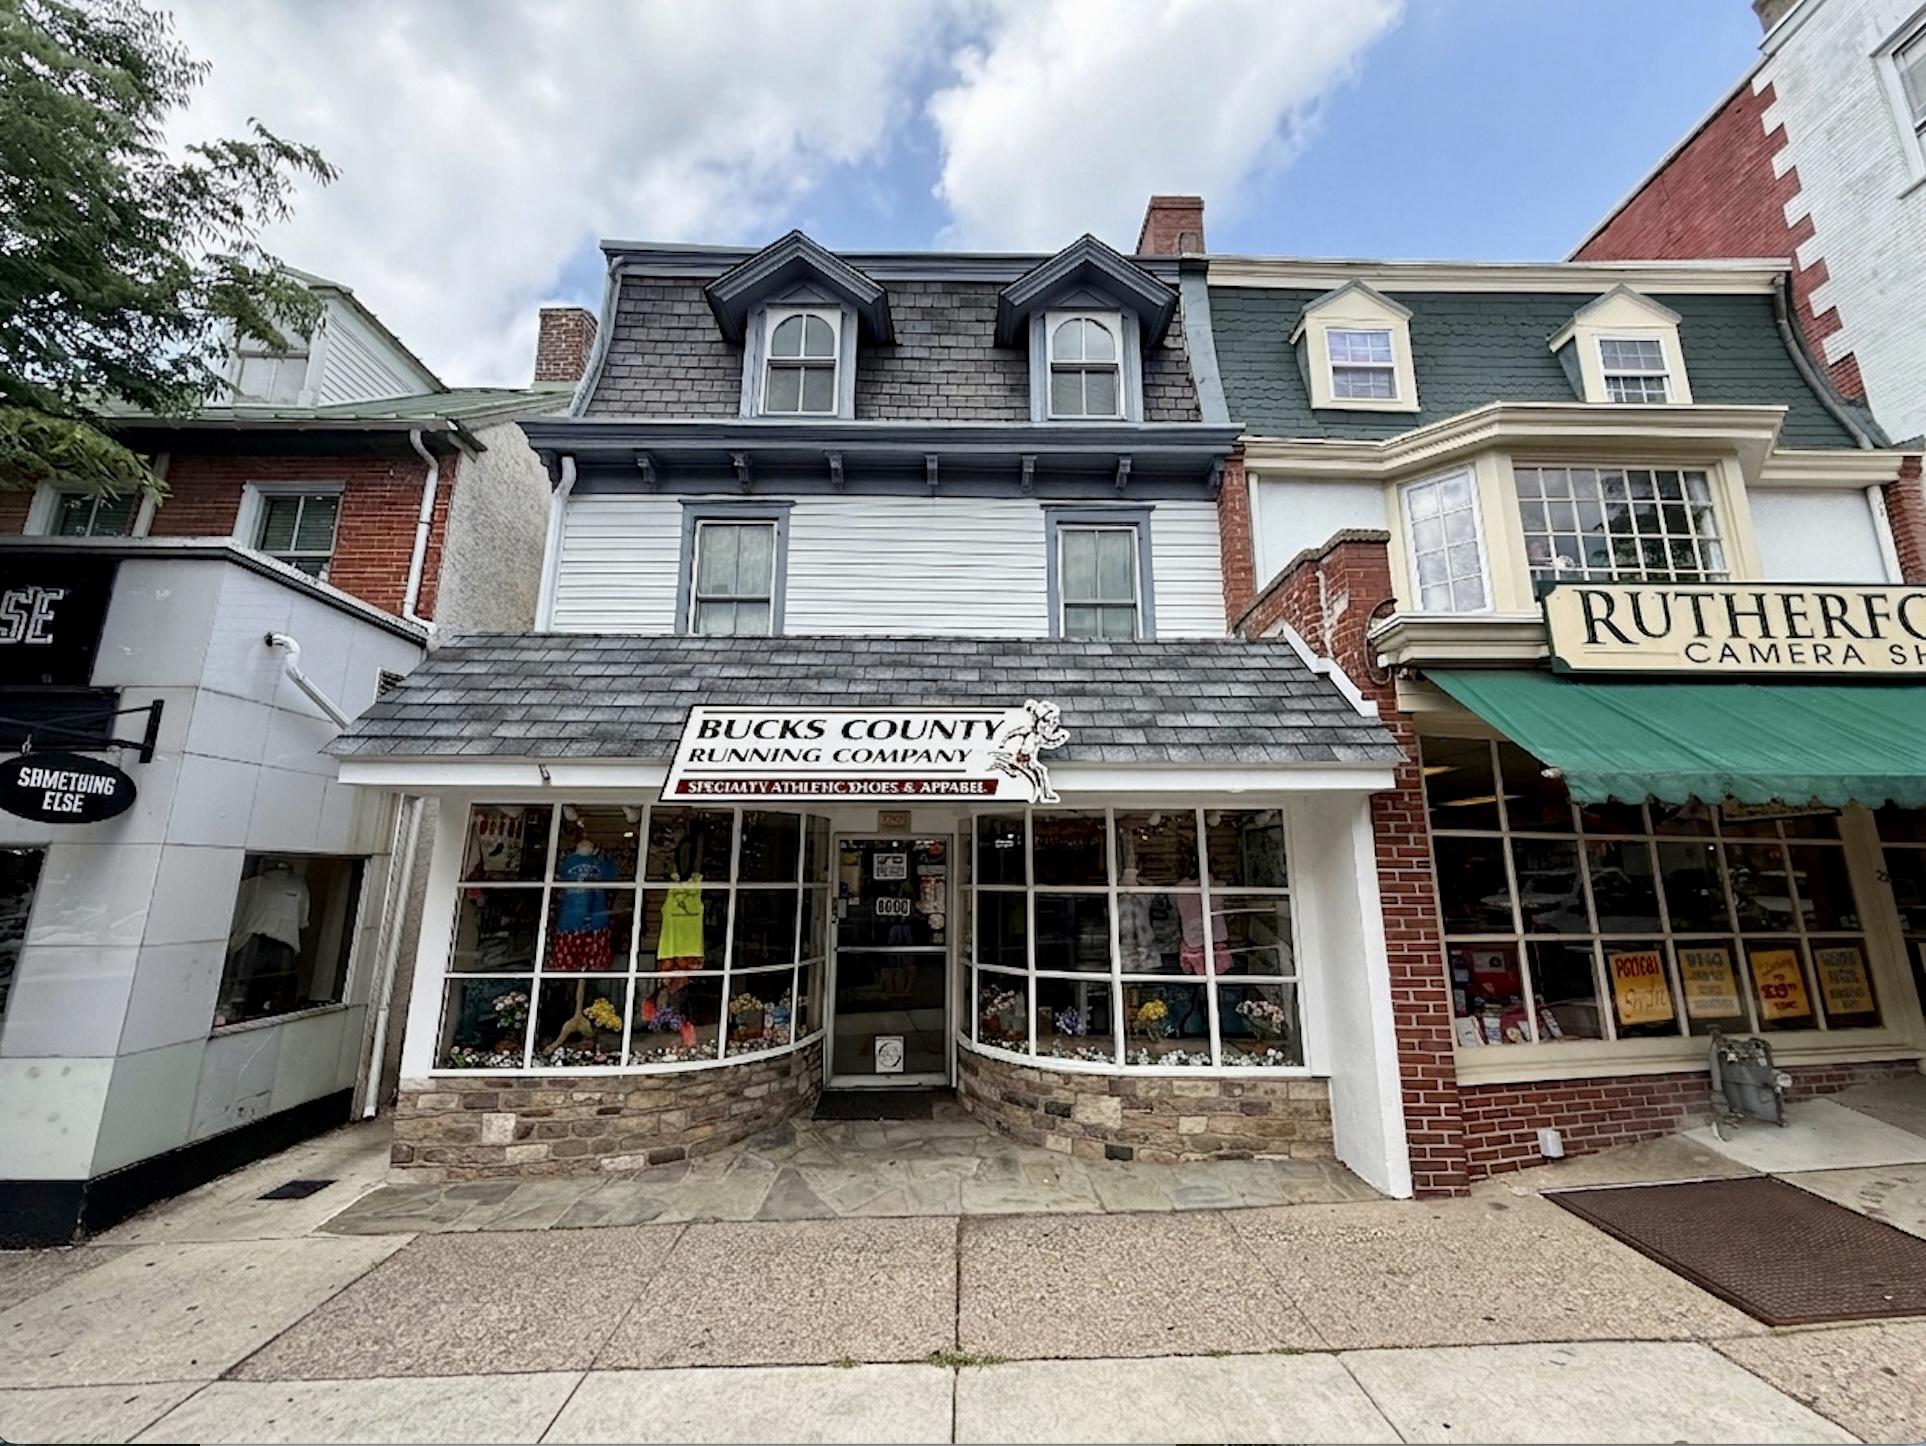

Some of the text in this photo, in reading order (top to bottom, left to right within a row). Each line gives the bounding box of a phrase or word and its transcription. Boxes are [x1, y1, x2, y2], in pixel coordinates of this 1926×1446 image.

[1684, 643, 1866, 665] CAMERA
[696, 719, 1005, 740] BUCKS COUNTY
[688, 748, 973, 764] RUNNING COMPANY
[17, 766, 117, 796] SOMETHING
[902, 781, 916, 794] &
[42, 790, 86, 813] ELSE
